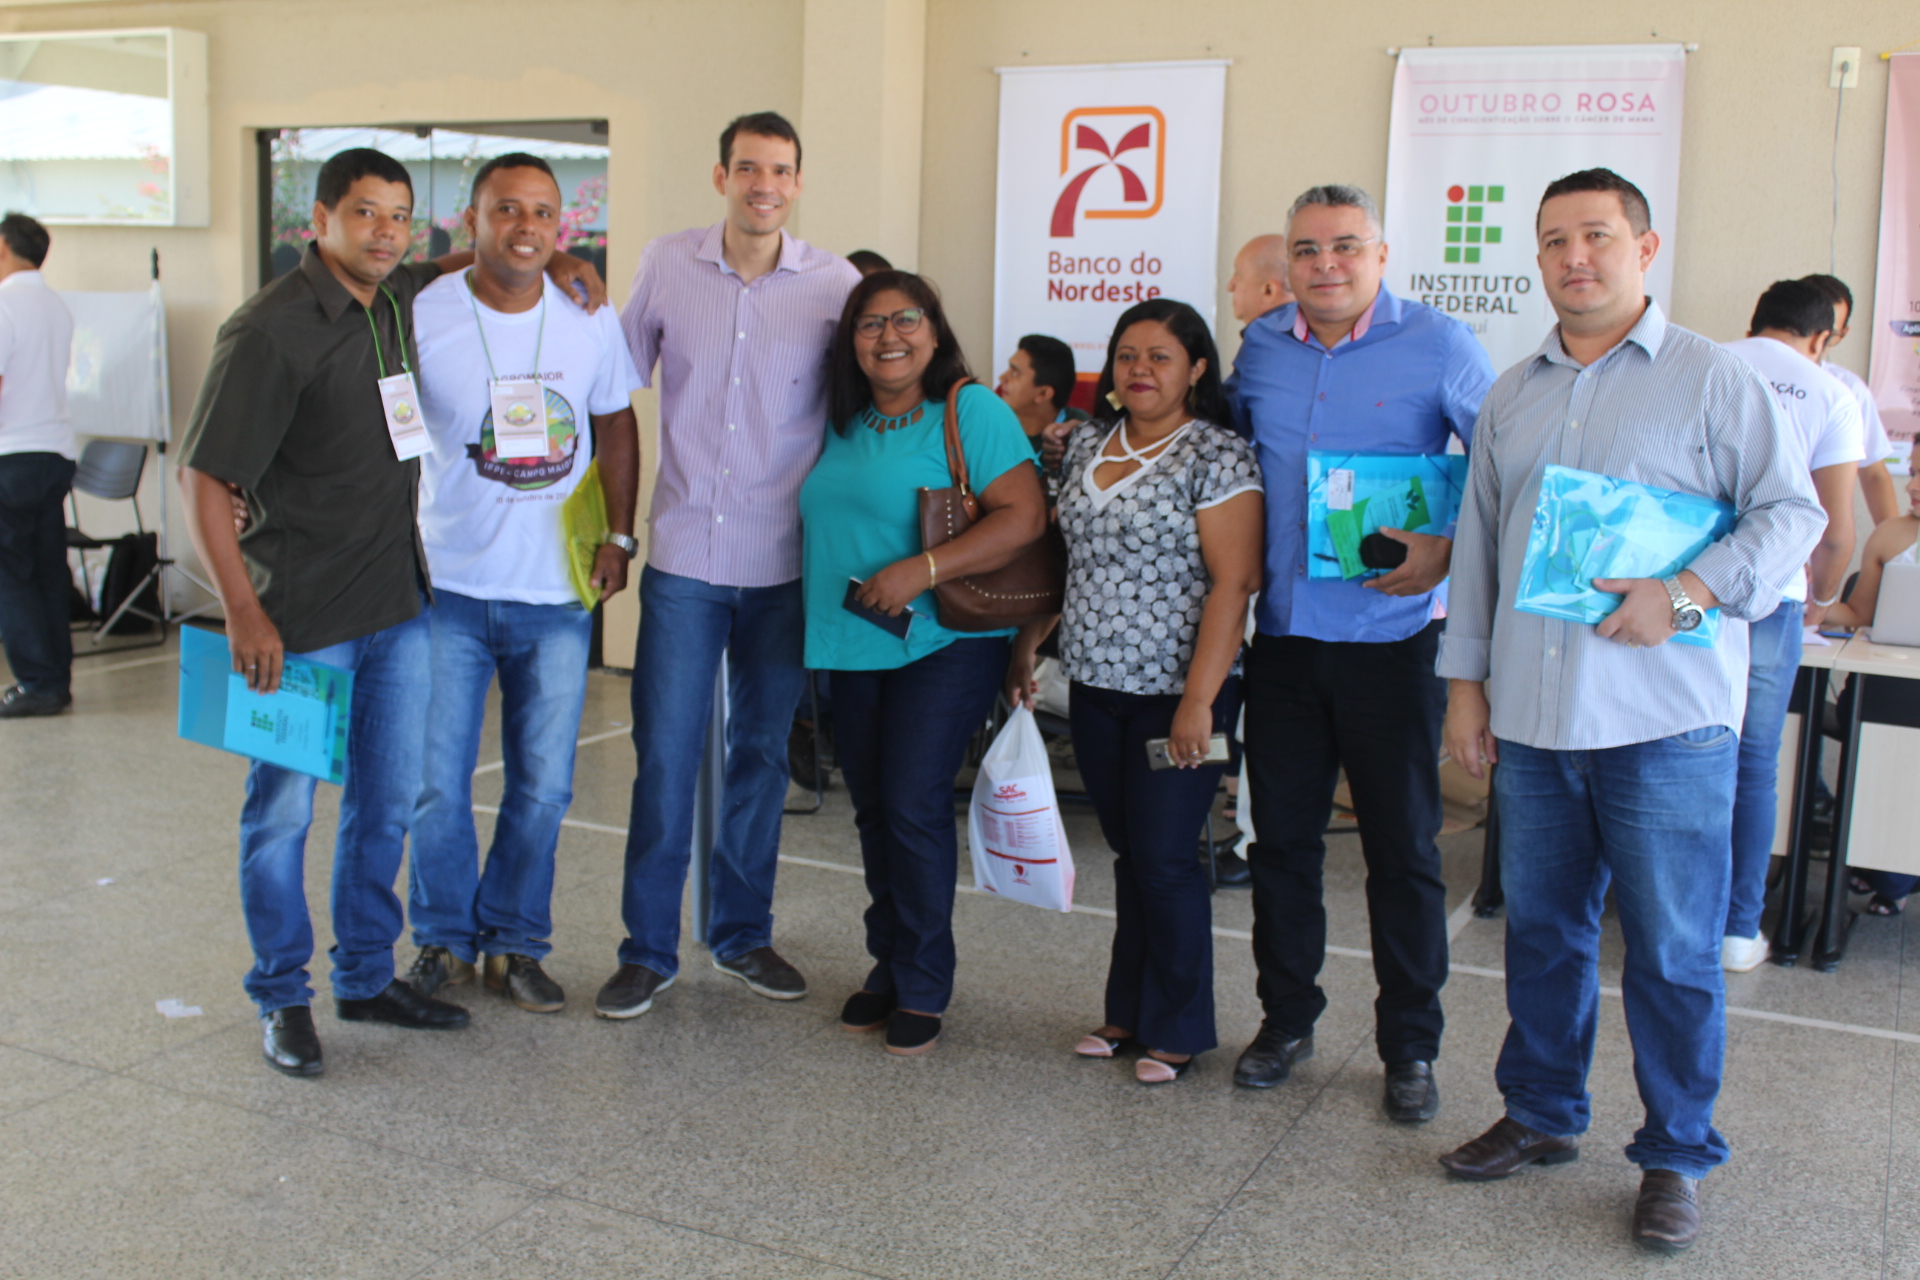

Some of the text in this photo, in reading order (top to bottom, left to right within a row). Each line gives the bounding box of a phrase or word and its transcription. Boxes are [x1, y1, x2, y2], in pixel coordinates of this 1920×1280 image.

[1420, 92, 1655, 114] OUTUBRO ROSA
[1049, 251, 1162, 275] Banco do
[1048, 279, 1160, 301] Nordeste
[1410, 274, 1531, 294] INSTITUTO
[514, 466, 546, 478] CAMPO
